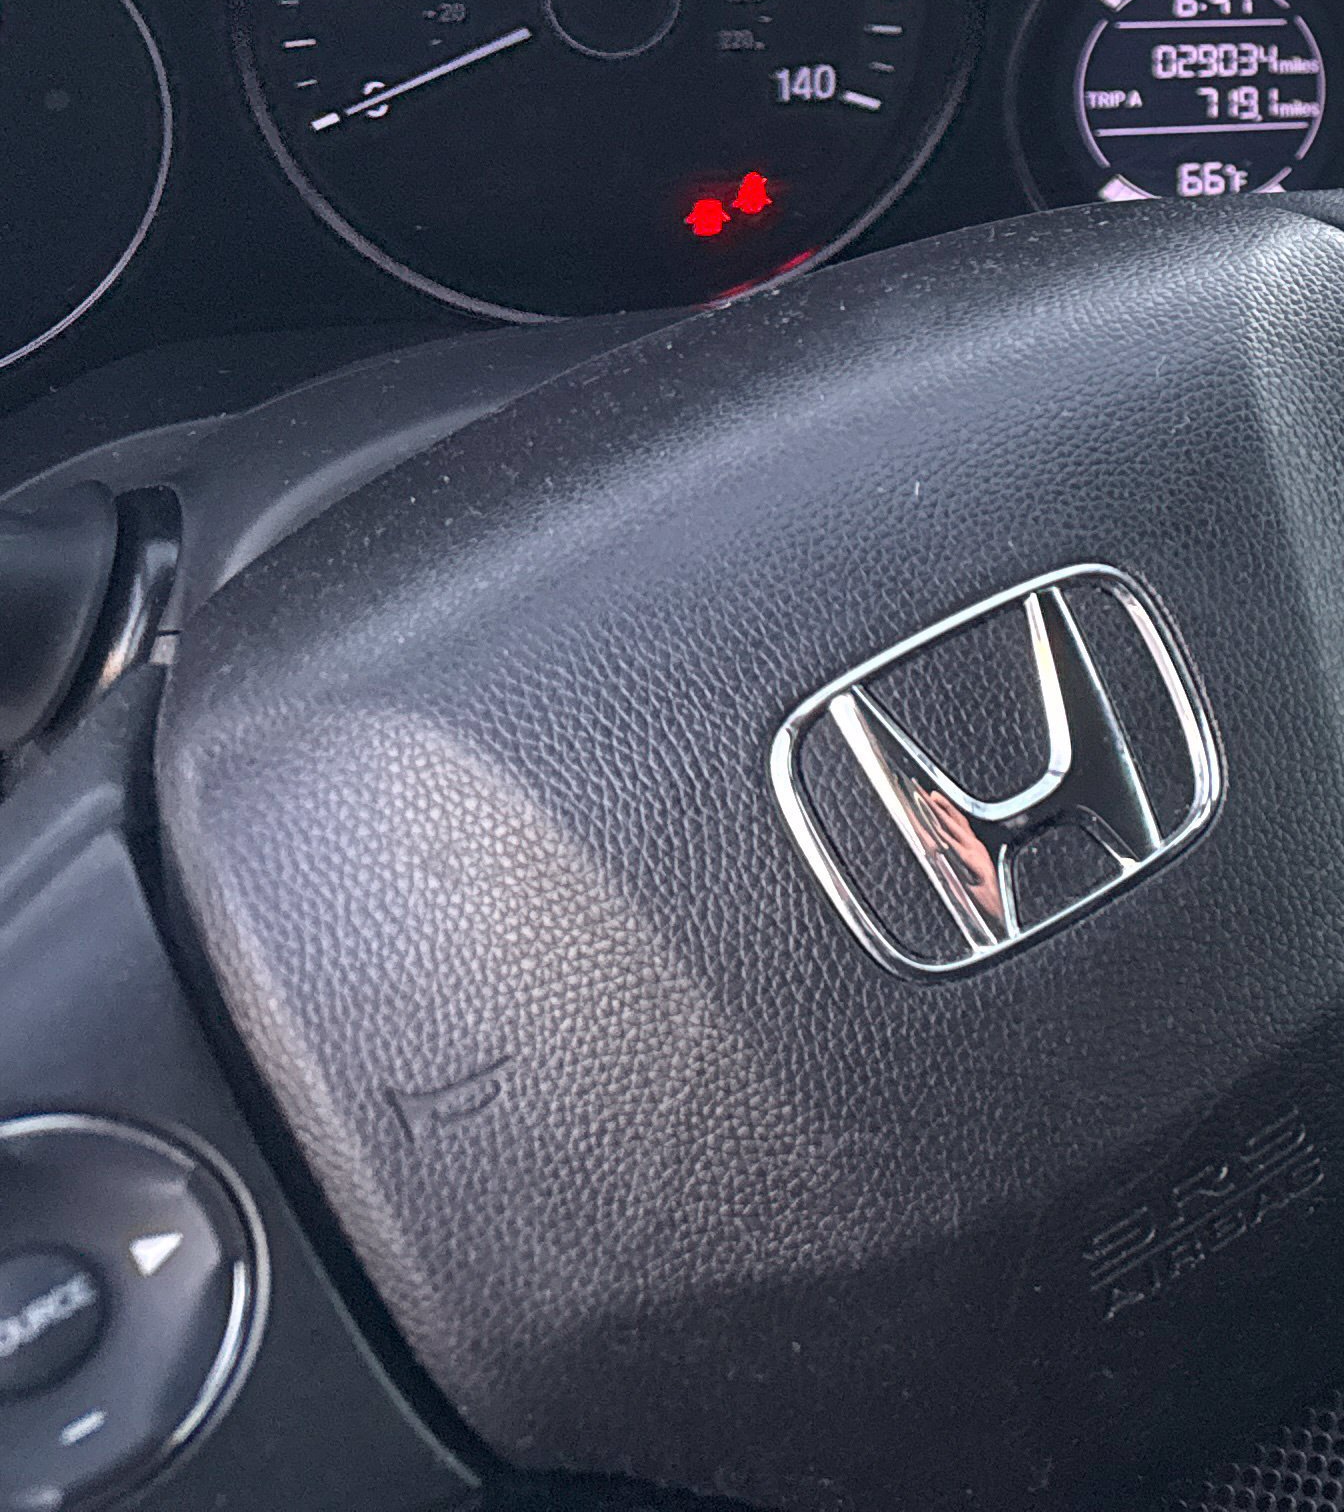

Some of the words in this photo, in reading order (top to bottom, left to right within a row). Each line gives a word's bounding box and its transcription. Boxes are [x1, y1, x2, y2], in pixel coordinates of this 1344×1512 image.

[1152, 43, 1279, 80] 029034
[777, 65, 837, 101] 140
[1085, 90, 1126, 109] TRIP
[1125, 89, 1143, 108] A
[1084, 1105, 1307, 1280] SRS
